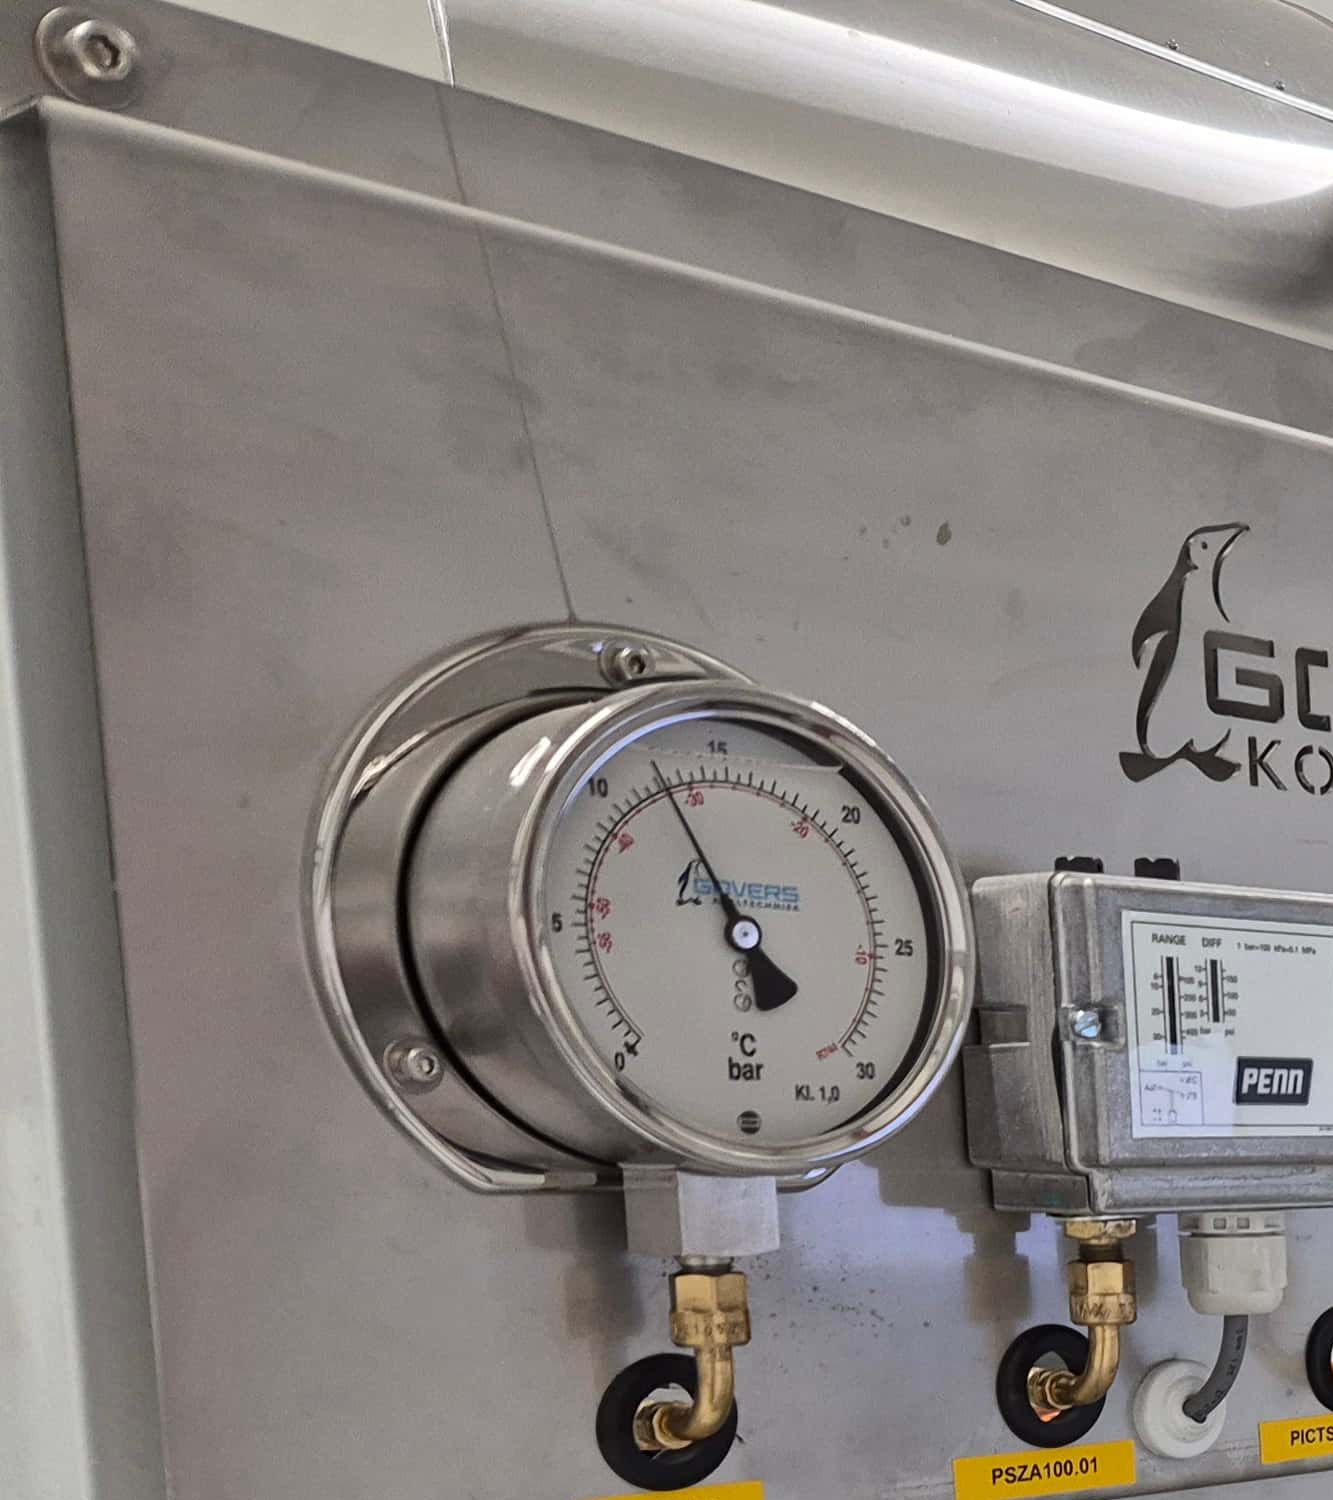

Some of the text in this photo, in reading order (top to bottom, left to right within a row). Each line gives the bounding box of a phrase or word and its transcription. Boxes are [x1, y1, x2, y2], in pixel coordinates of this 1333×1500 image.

[706, 740, 728, 756] 15
[588, 776, 609, 798] 10
[841, 805, 862, 826] 20
[551, 912, 564, 933] 5
[894, 938, 915, 957] 25
[1151, 932, 1187, 947] RANGE
[1201, 936, 1223, 948] DIFF
[614, 1051, 626, 1072] 0
[728, 1056, 764, 1081] bar
[856, 1062, 876, 1081] 30
[1241, 1066, 1305, 1096] PENN
[990, 1455, 1100, 1487] PSZA100.01
